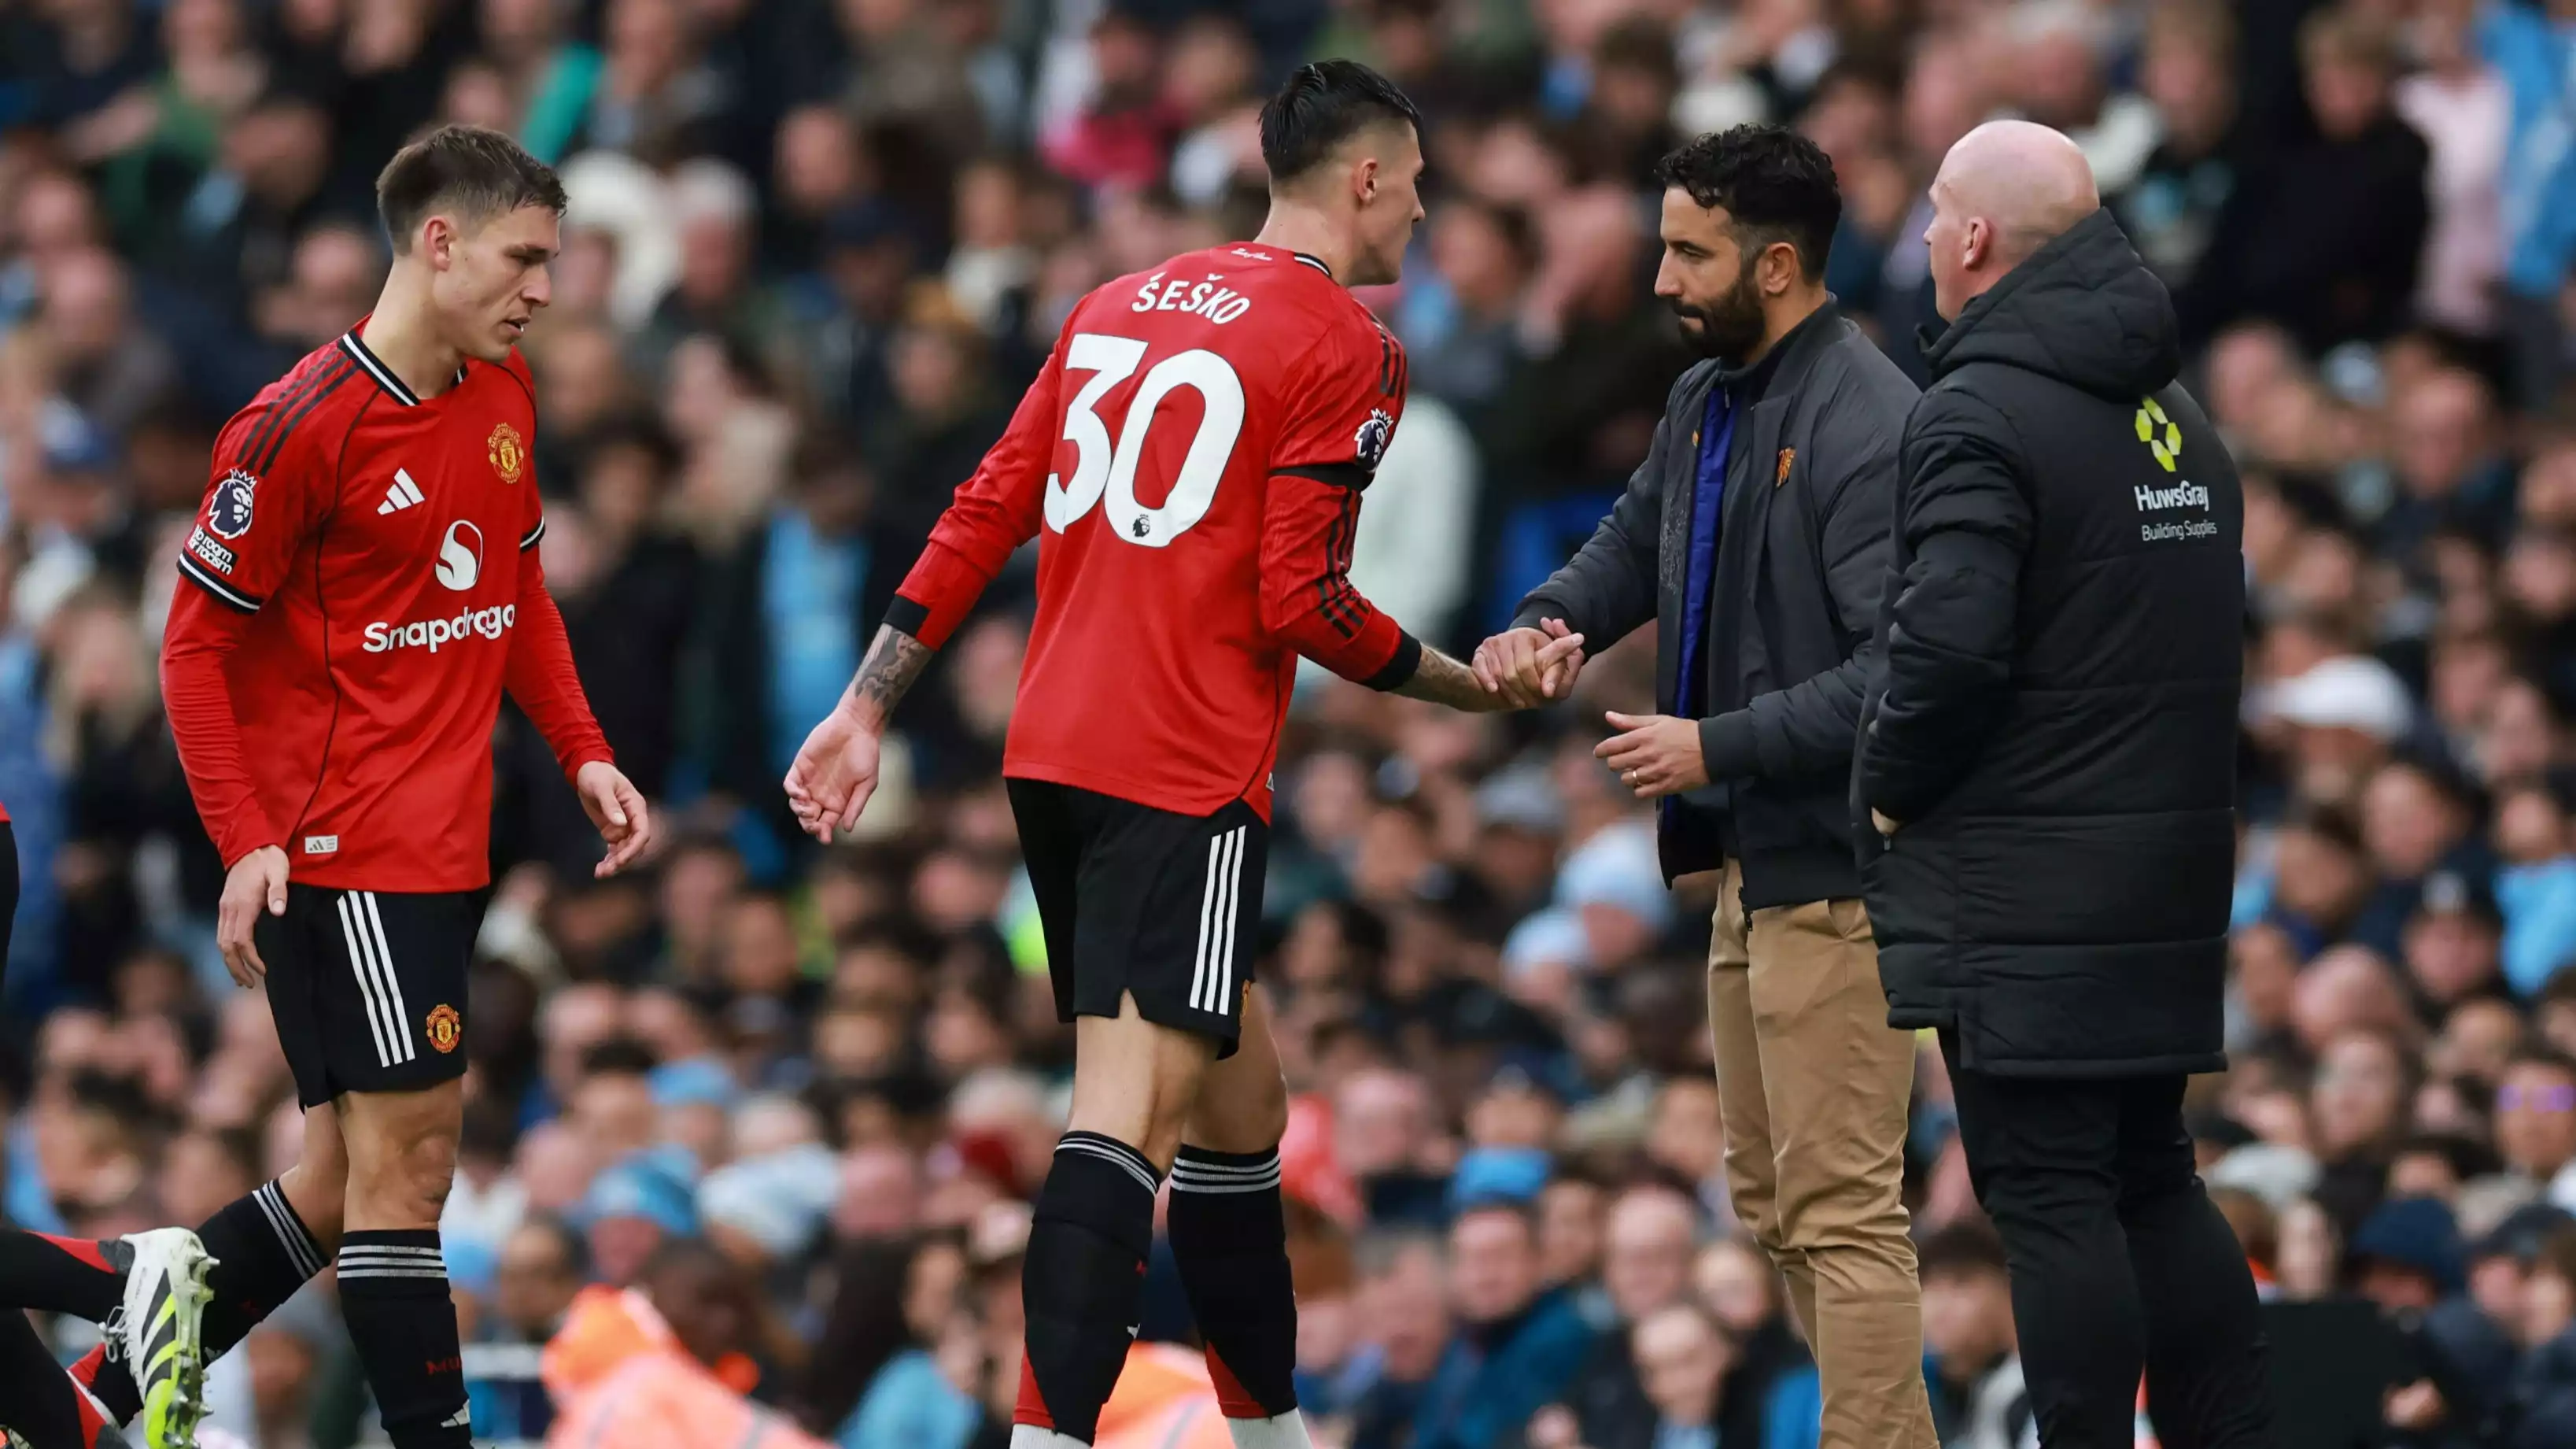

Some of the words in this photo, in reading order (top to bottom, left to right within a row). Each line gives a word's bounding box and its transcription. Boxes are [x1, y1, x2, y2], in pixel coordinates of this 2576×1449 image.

[1043, 333, 1246, 547] 30
[2134, 480, 2209, 511] HuwsGray
[2142, 523, 2184, 542] Building
[2184, 519, 2217, 538] Supplies
[196, 545, 232, 575] racism
[202, 536, 232, 563] room
